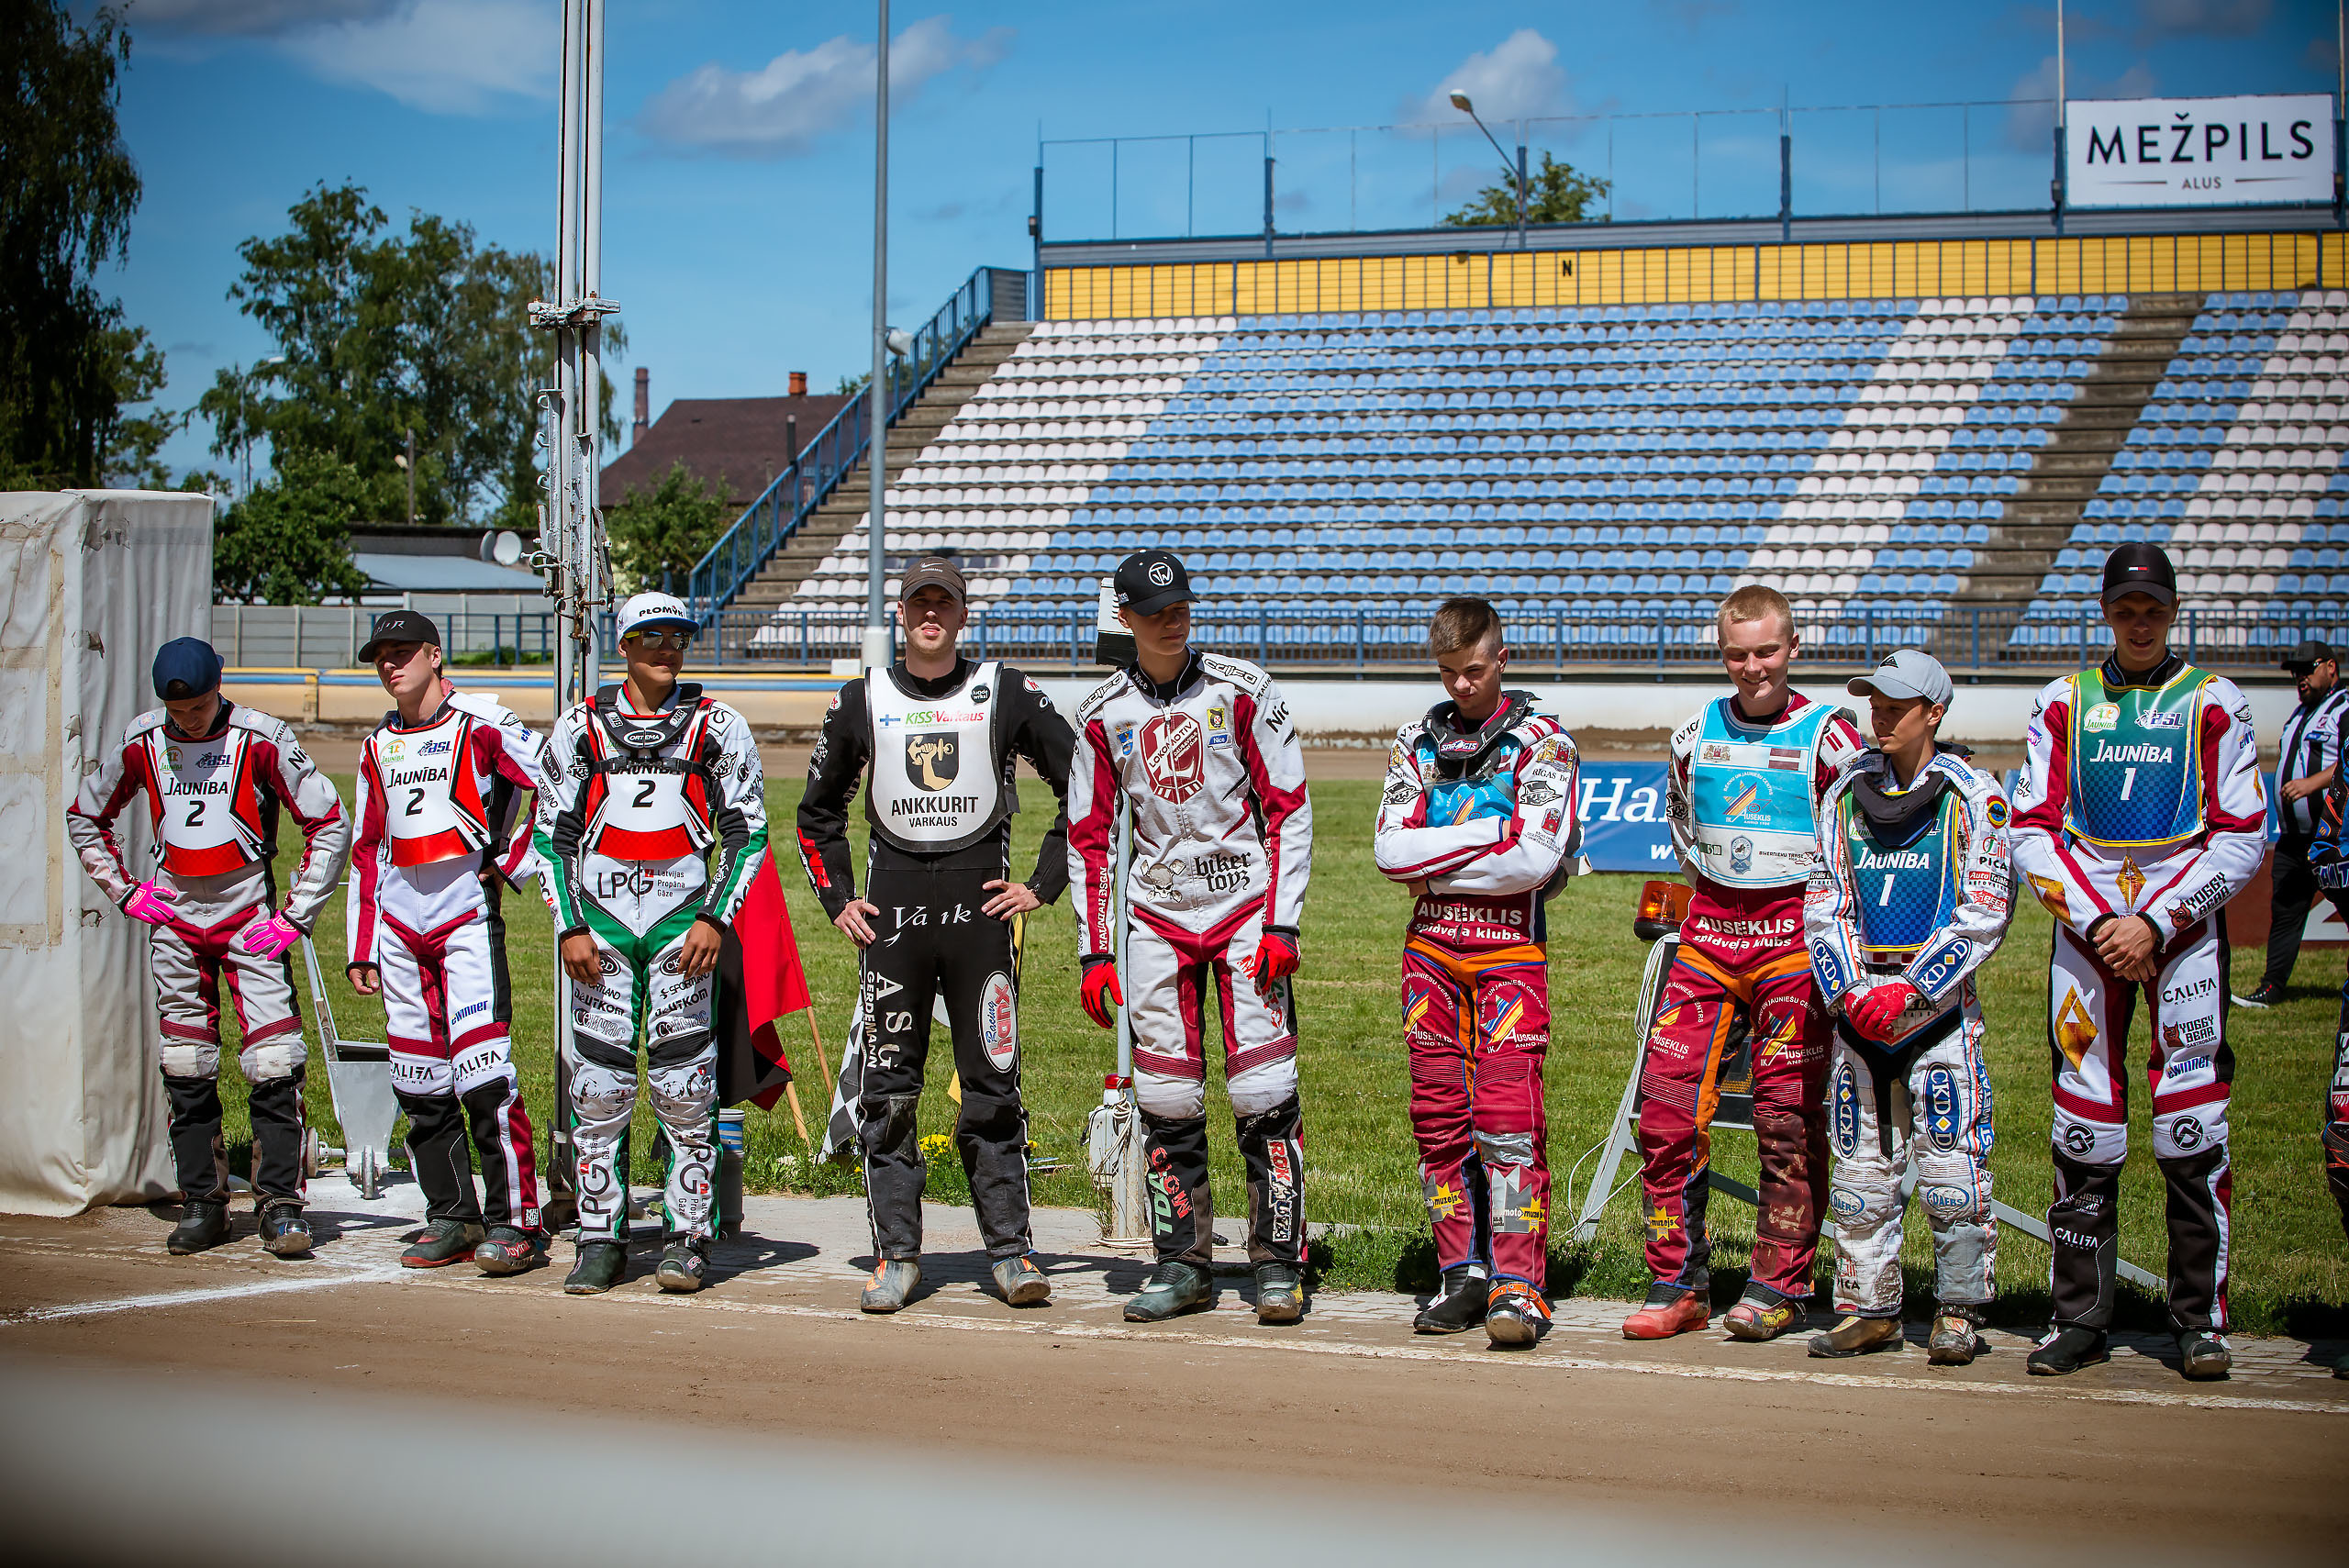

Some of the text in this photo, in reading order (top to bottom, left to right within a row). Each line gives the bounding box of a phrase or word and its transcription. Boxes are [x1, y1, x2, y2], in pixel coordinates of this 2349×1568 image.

[2087, 112, 2314, 164] MEŽPILS
[2181, 176, 2222, 190] ALUS
[906, 711, 933, 725] KiSS
[1149, 721, 1193, 768] LOKOMOTIV
[2089, 739, 2173, 763] JAUNĪBA
[387, 767, 448, 788] JAUNĪBA
[1950, 762, 1967, 781] METAL
[164, 777, 228, 796] JAUNĪBA
[632, 780, 656, 808] 2
[2121, 767, 2136, 800] 1
[406, 788, 425, 817] 2
[891, 796, 979, 817] ANKKURIT
[1577, 778, 1669, 823] Ha
[184, 800, 206, 827] 2
[908, 816, 958, 828] VARKAUS
[1731, 808, 1772, 822] AUSEKLIS
[1193, 851, 1252, 876] biker
[1854, 847, 1930, 870] JAUNĪBA
[1979, 856, 2009, 872] PICA
[597, 871, 654, 899] LPG
[657, 880, 685, 889] Propāna
[1878, 873, 1896, 906] 1
[1970, 872, 1989, 880] Auto
[1990, 873, 2009, 886] Trials
[2186, 872, 2229, 909] YOGGY
[657, 889, 674, 897] Gāze
[1418, 902, 1522, 926] AUSEKLIS
[1475, 927, 1521, 940] klubs
[1696, 916, 1796, 936] AUSEKLIS
[1813, 943, 1837, 982] CKD
[865, 971, 878, 1069] GERDEMANN
[986, 1001, 997, 1044] Racing
[2179, 1015, 2214, 1034] YOGGY
[1648, 1029, 1690, 1055] AUSEKLIS
[2186, 1026, 2215, 1043] BEAR
[2186, 1035, 2218, 1049] GASTROBARS
[1487, 1046, 1496, 1054] IK
[1652, 1045, 1669, 1054] ANNO
[1768, 1044, 1824, 1066] AUSEKLIS
[1931, 1069, 1951, 1115] CKD
[1840, 1104, 1854, 1149] CKD
[1265, 1140, 1291, 1182] ROK
[581, 1164, 611, 1231] LPG
[1152, 1171, 1173, 1236] TDA
[1505, 1208, 1522, 1218] moto
